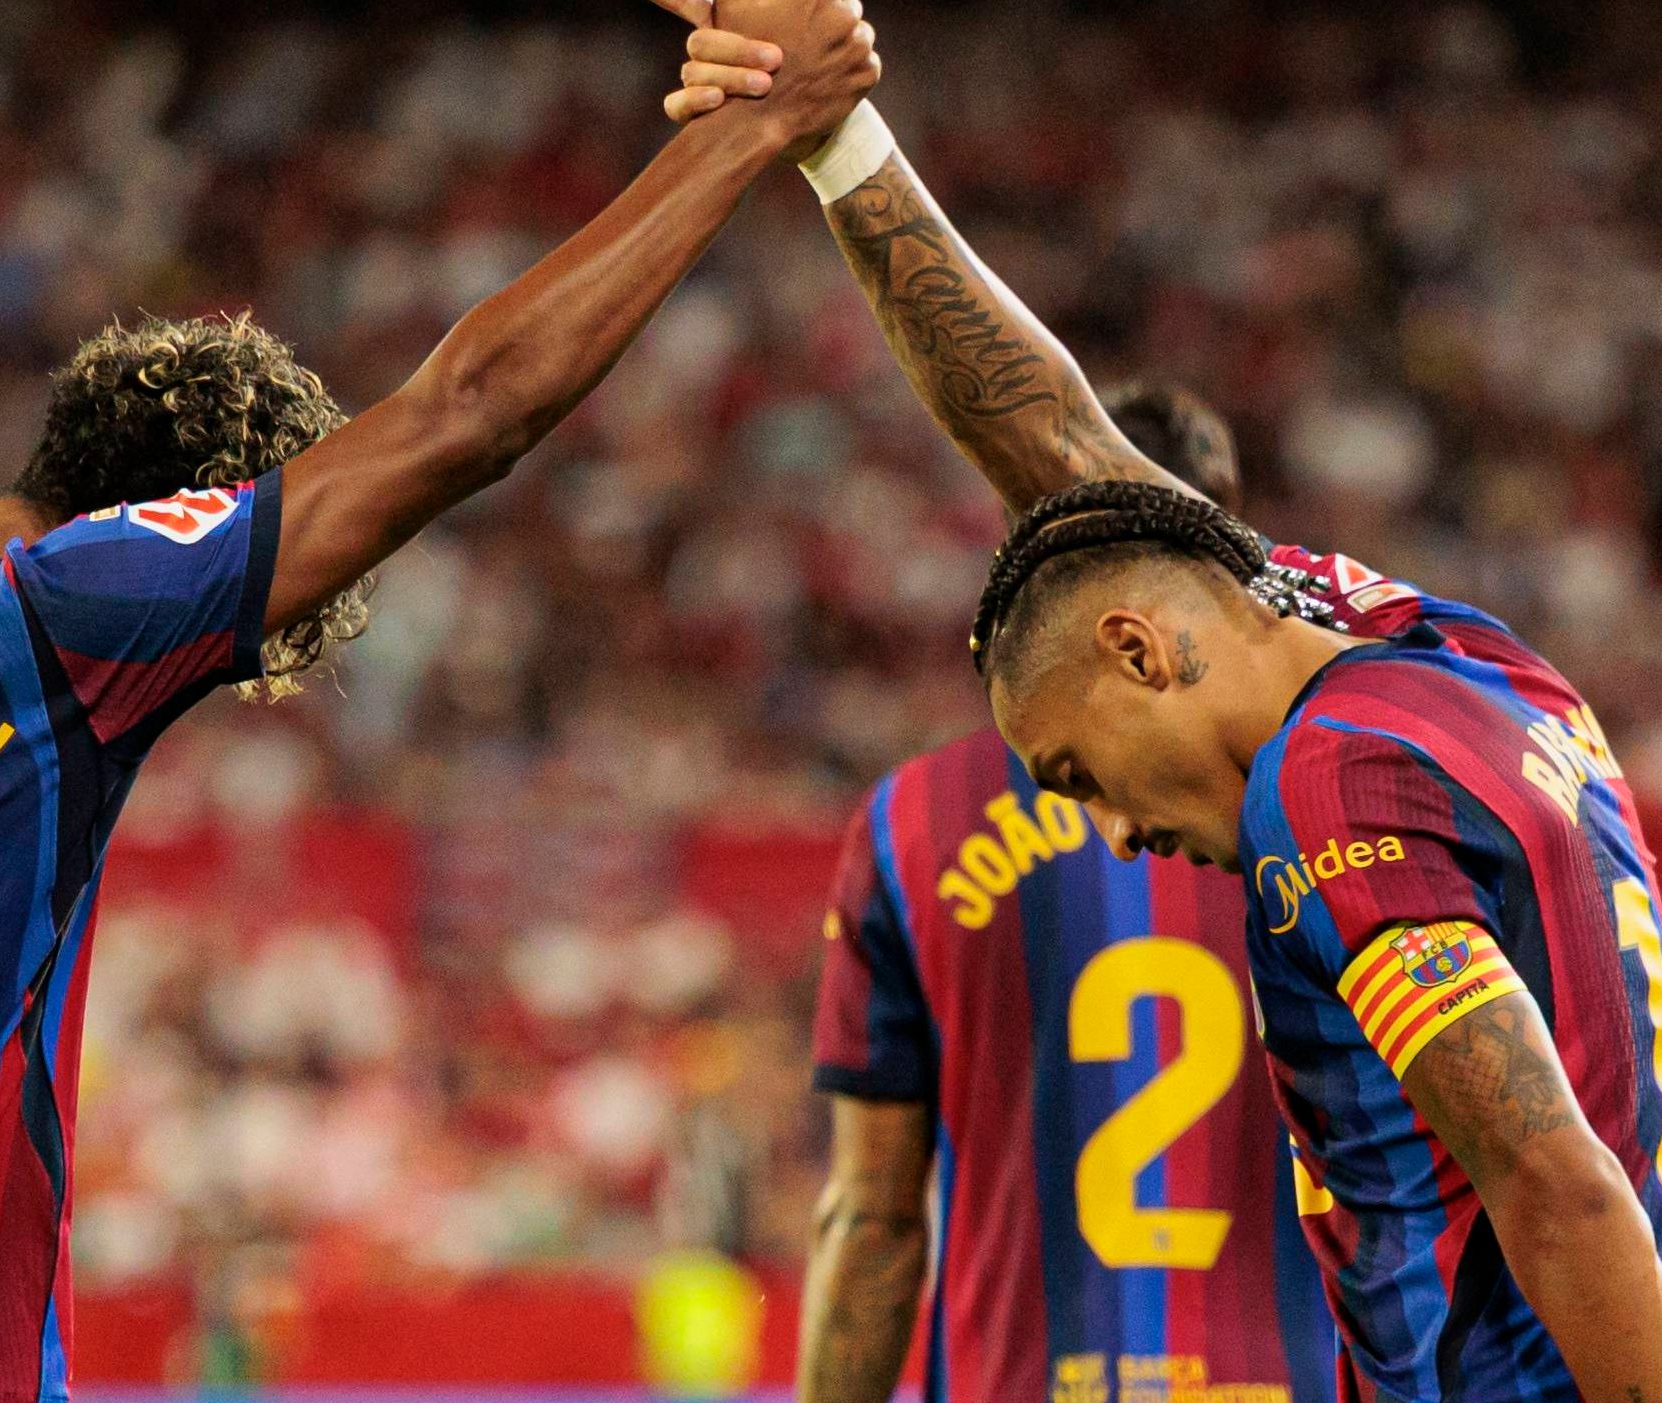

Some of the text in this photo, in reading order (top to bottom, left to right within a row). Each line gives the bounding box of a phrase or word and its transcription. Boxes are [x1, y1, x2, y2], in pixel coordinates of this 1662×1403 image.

[939, 790, 1087, 929] JOÃO
[1255, 835, 1405, 934] Midea
[1068, 936, 1245, 1269] 2
